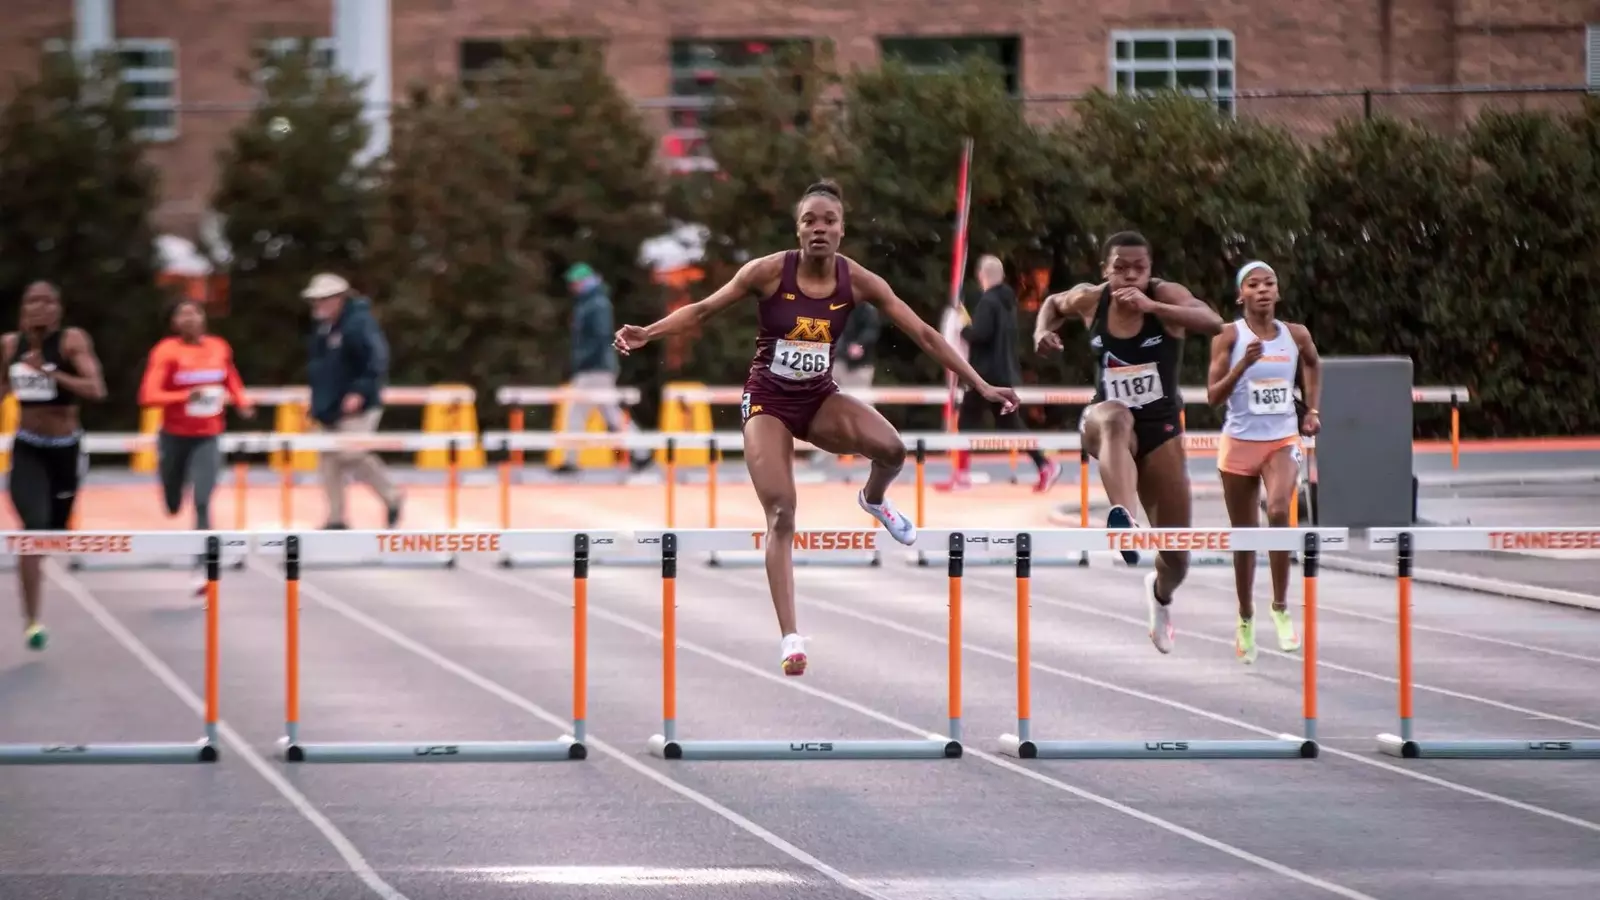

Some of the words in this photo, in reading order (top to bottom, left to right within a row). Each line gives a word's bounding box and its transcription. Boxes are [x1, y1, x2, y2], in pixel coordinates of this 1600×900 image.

[781, 351, 825, 373] 1266
[1111, 374, 1155, 398] 1187
[1253, 388, 1287, 405] 1367
[7, 535, 132, 553] TENNESSEE
[376, 534, 501, 552] TENNESSEE
[752, 532, 877, 550] TNESSEE
[1107, 532, 1231, 550] TENNESSEE
[414, 746, 458, 756] UCS
[790, 742, 833, 751] UCS
[1145, 742, 1189, 751] UCS
[1528, 741, 1572, 750] UCS
